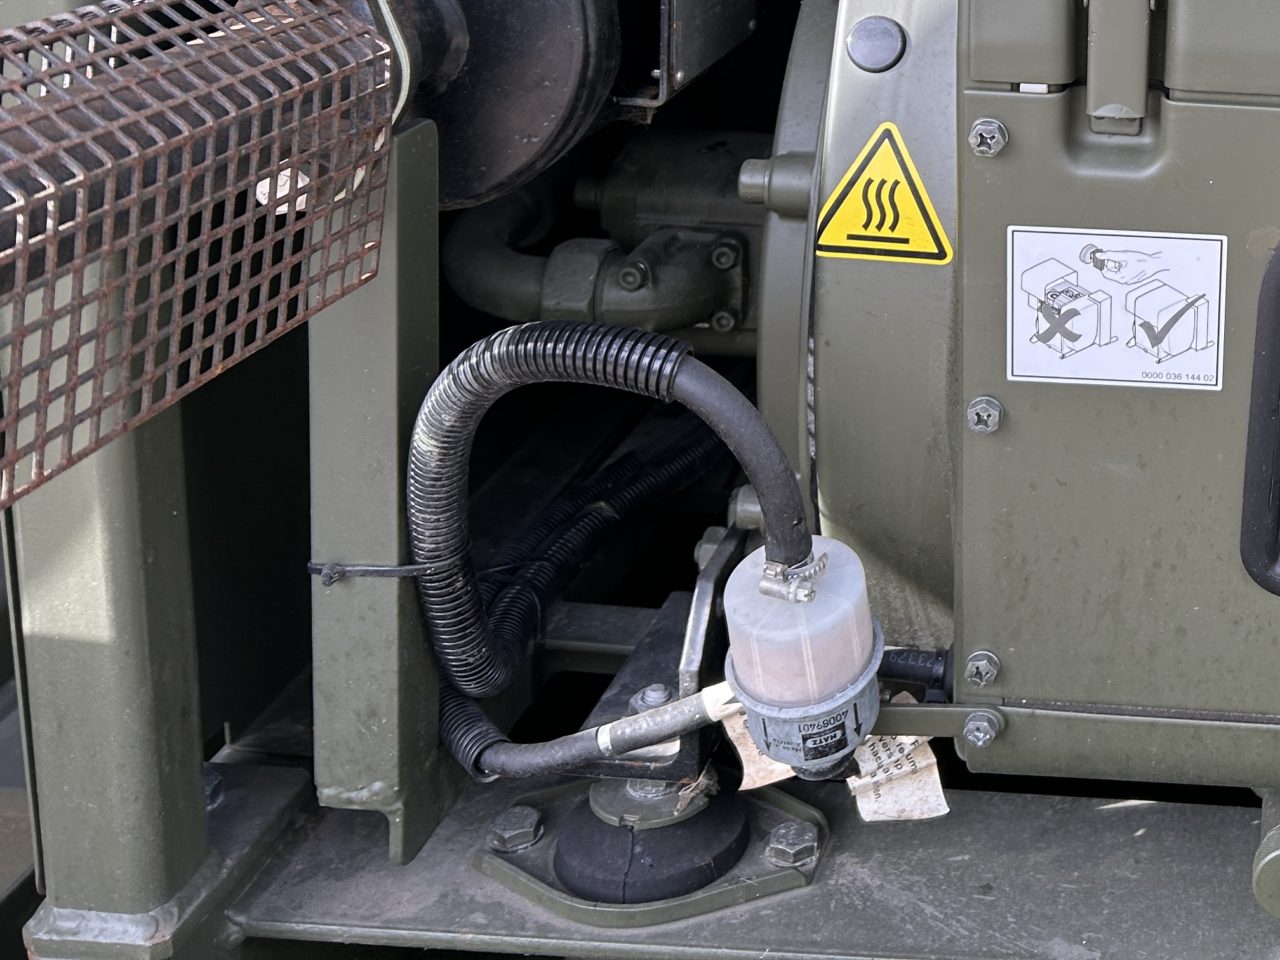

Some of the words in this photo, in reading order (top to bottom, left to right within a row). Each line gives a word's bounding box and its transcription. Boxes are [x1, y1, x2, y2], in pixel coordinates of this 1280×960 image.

[1141, 371, 1164, 380] 0000
[1165, 372, 1182, 380] 036
[1185, 373, 1202, 381] 144
[1203, 374, 1215, 382] 02
[798, 709, 849, 733] 40089401
[812, 733, 837, 746] HATZ
